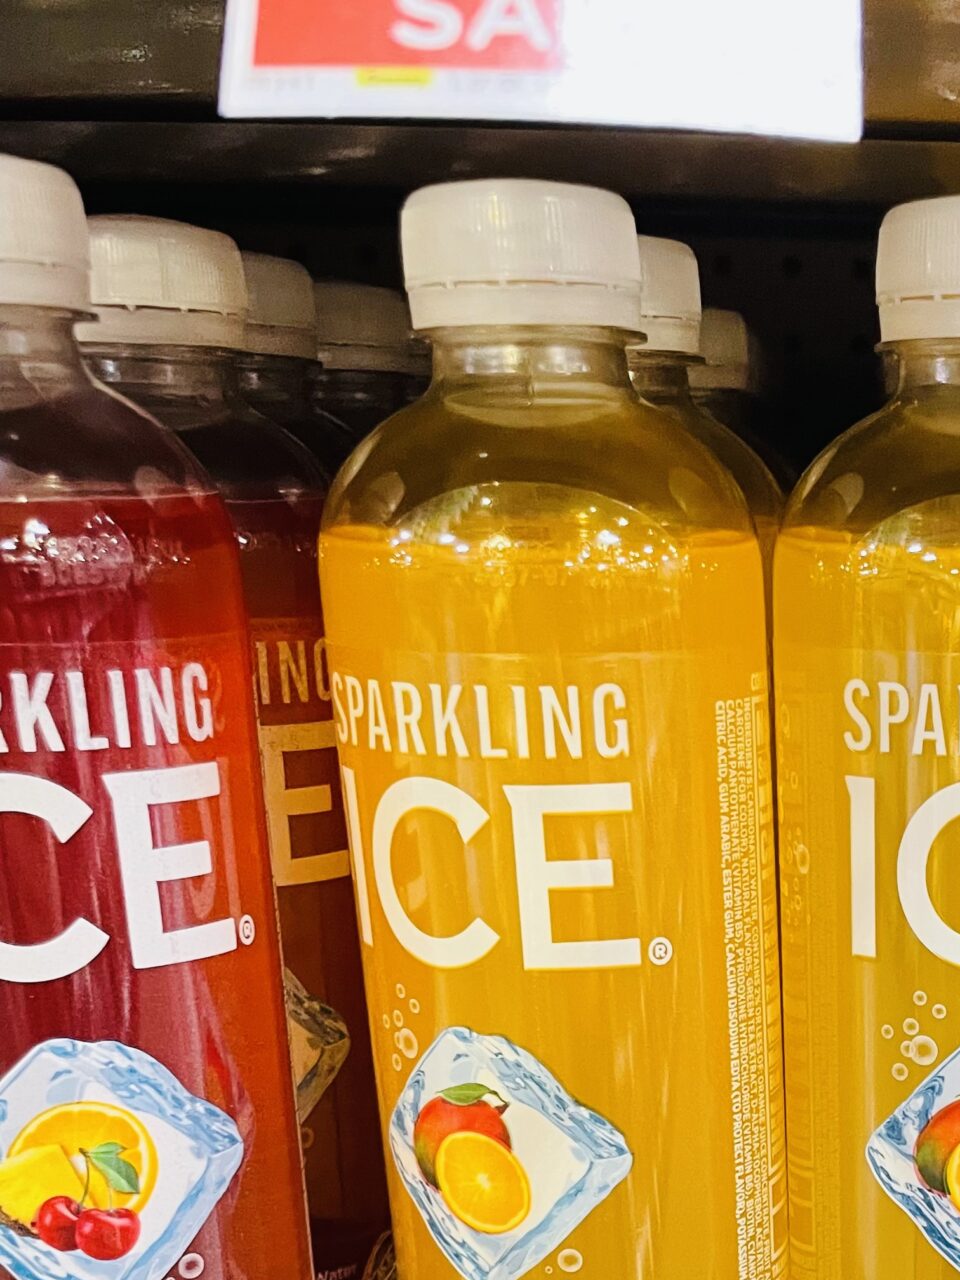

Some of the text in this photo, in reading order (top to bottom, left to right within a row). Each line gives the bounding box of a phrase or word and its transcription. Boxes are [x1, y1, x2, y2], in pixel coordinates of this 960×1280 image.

[0, 663, 214, 753] KLING
[332, 671, 630, 760] SPARKLING
[715, 700, 727, 742] CITRIC
[725, 700, 737, 757] CALCIUM
[735, 699, 745, 769] CAROTENE
[717, 746, 729, 783] ACID,
[744, 697, 755, 789] INGREDIENTS:
[719, 783, 730, 813] GUM
[728, 760, 741, 861] PANTOTHENATE
[737, 770, 747, 801] (FOR
[720, 815, 732, 868] ARABIC,
[746, 791, 758, 873] CARBONATED
[341, 765, 643, 971] ICE
[723, 869, 733, 908] ESTER
[732, 863, 742, 920] (VITAMIN
[741, 857, 751, 916] NATURAL
[724, 910, 735, 944] GUM,
[726, 943, 737, 998] CALCIUM
[751, 926, 761, 986] CONTAINS
[735, 948, 746, 1022] PYRIDOXINE
[746, 978, 754, 1017] GREEN
[728, 999, 739, 1057] DISODIUM
[755, 1006, 762, 1023] OR
[755, 1024, 763, 1053] LESS
[731, 1060, 741, 1090] EDTA
[739, 1023, 751, 1120] HYDROCHLORIDE
[732, 1091, 742, 1112] (TO
[757, 1077, 766, 1125] ORANGE
[733, 1113, 744, 1164] PROTECT
[743, 1122, 753, 1172] (VITAMIN
[759, 1125, 767, 1156] JUICE
[737, 1219, 748, 1280] POTASSIUM
[755, 1226, 764, 1275] ACETATE
[763, 1239, 771, 1271] FRUIT
